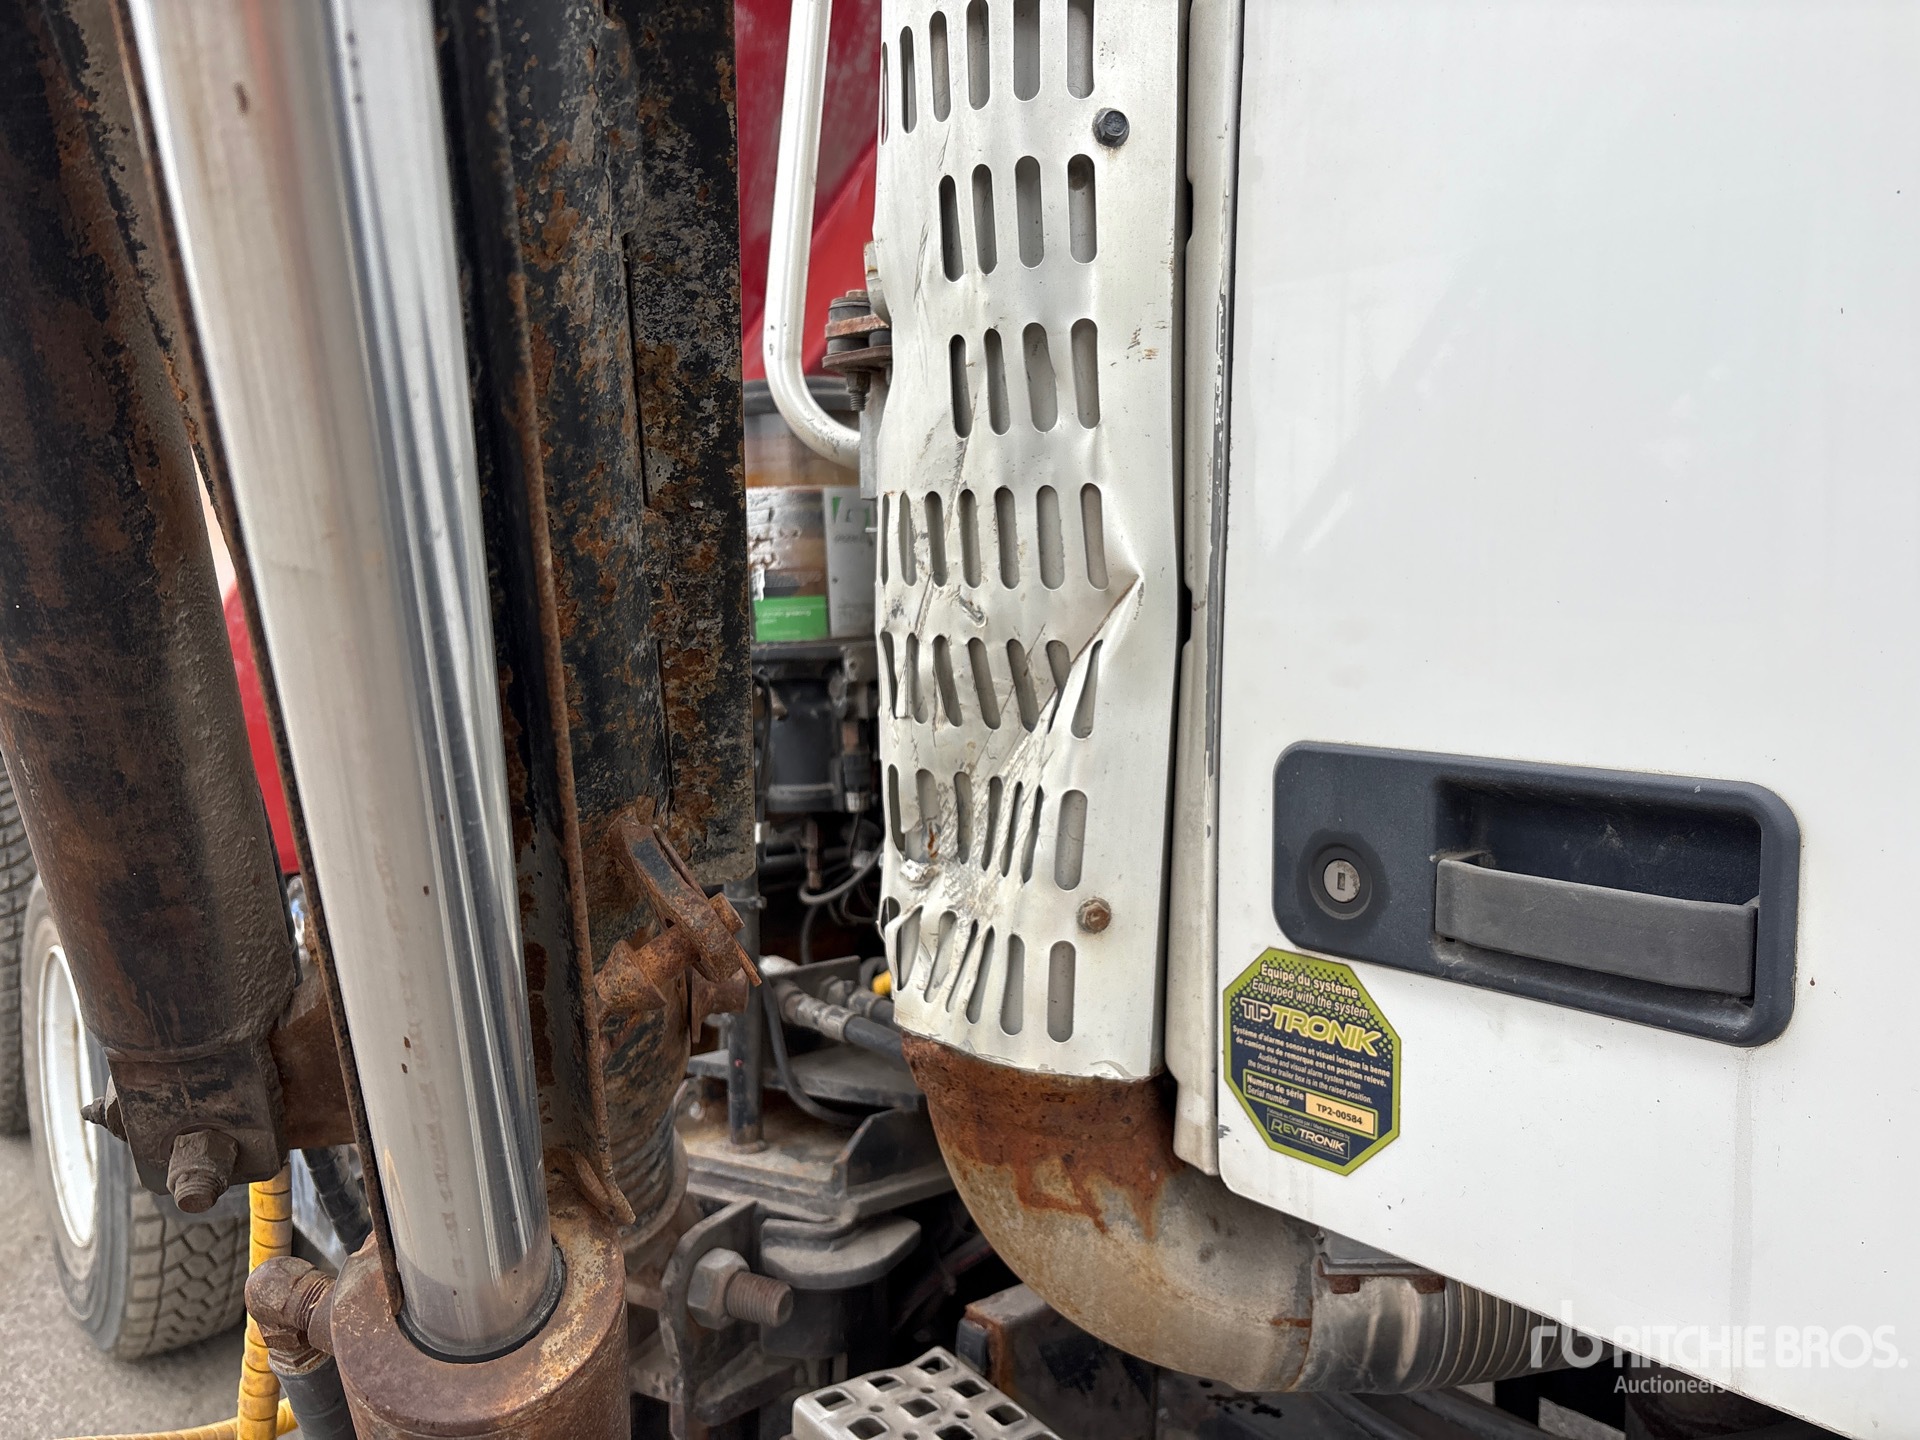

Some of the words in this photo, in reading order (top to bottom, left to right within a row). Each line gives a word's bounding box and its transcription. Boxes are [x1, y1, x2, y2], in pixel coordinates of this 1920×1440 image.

[1252, 978, 1294, 998] Equipped
[1296, 991, 1315, 1005] with
[1317, 996, 1332, 1008] the
[1334, 1002, 1369, 1018] system
[1261, 962, 1295, 982] Équipé
[1298, 975, 1310, 987] du
[1313, 979, 1359, 998] système
[1235, 1036, 1243, 1044] de
[1244, 1040, 1266, 1051] camion
[1266, 1046, 1274, 1054] ou
[1275, 1048, 1284, 1056] de
[1284, 1052, 1314, 1065] remorque
[1315, 1061, 1326, 1069] est
[1327, 1064, 1335, 1072] en
[1336, 1067, 1363, 1080] position
[1364, 1075, 1387, 1088] relevé.
[1258, 1033, 1284, 1046] d'alarme
[1286, 1042, 1307, 1053] sonore
[1308, 1048, 1315, 1056] et
[1316, 1050, 1335, 1061] visuel
[1336, 1055, 1361, 1068] lorsque
[1361, 1062, 1368, 1071] la
[1370, 1065, 1390, 1077] benne
[1258, 1052, 1278, 1065] Audible
[1279, 1060, 1290, 1068] and
[1290, 1063, 1307, 1073] visual
[1307, 1068, 1323, 1078] alarm
[1324, 1073, 1344, 1085] system
[1345, 1080, 1361, 1090] when
[1247, 1074, 1274, 1090] Numéro
[1275, 1084, 1285, 1094] de
[1286, 1088, 1304, 1101] série
[1247, 1084, 1265, 1097] Serial
[1265, 1092, 1290, 1106] number
[1248, 1059, 1256, 1068] the
[1257, 1062, 1270, 1072] truck
[1278, 1069, 1294, 1079] trailer
[1295, 1074, 1305, 1082] box
[1312, 1079, 1318, 1087] in
[1318, 1081, 1328, 1090] the
[1329, 1085, 1347, 1096] raised
[1347, 1090, 1373, 1103] position.
[1316, 1103, 1363, 1125] TP2-00584
[1271, 1118, 1345, 1152] REVTRONIK
